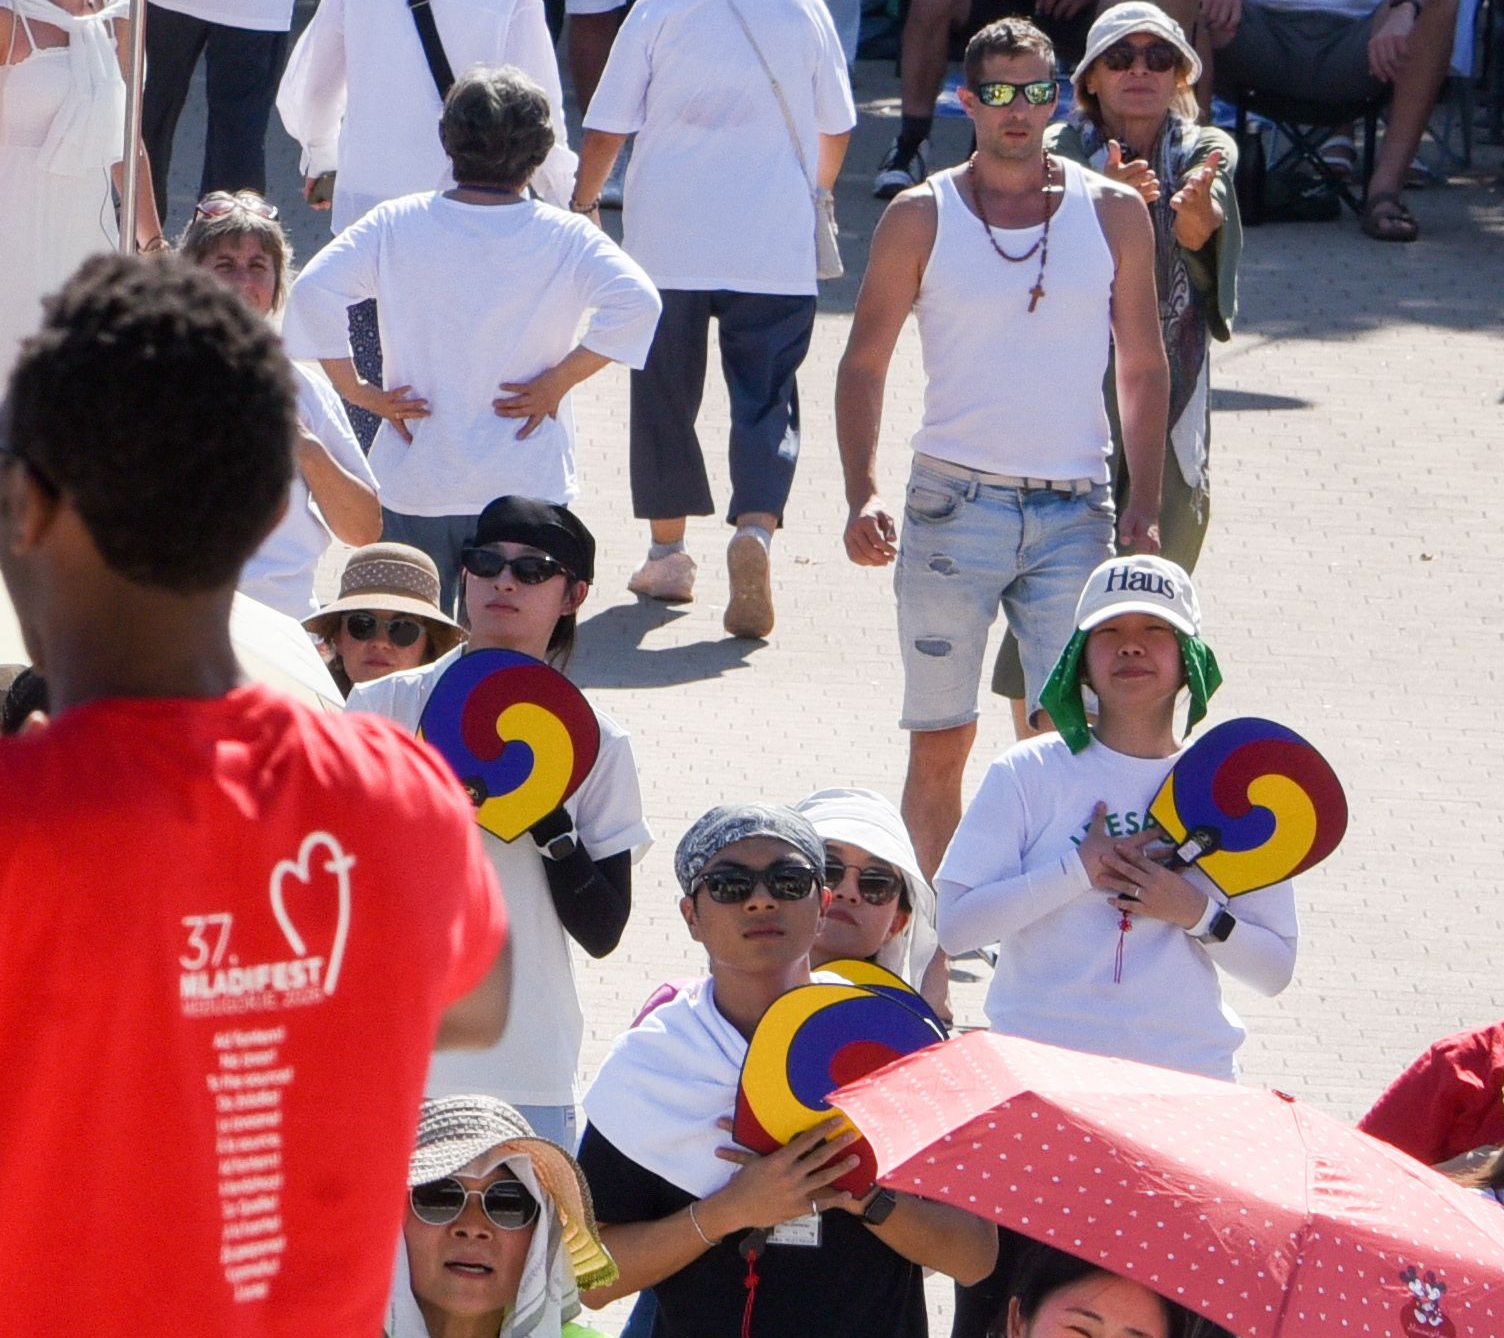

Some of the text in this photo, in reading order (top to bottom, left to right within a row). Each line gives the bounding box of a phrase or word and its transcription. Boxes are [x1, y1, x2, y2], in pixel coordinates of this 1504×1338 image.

[1105, 565, 1175, 599] Haus
[179, 913, 239, 970] 37.
[180, 956, 323, 999] MLADIFEST
